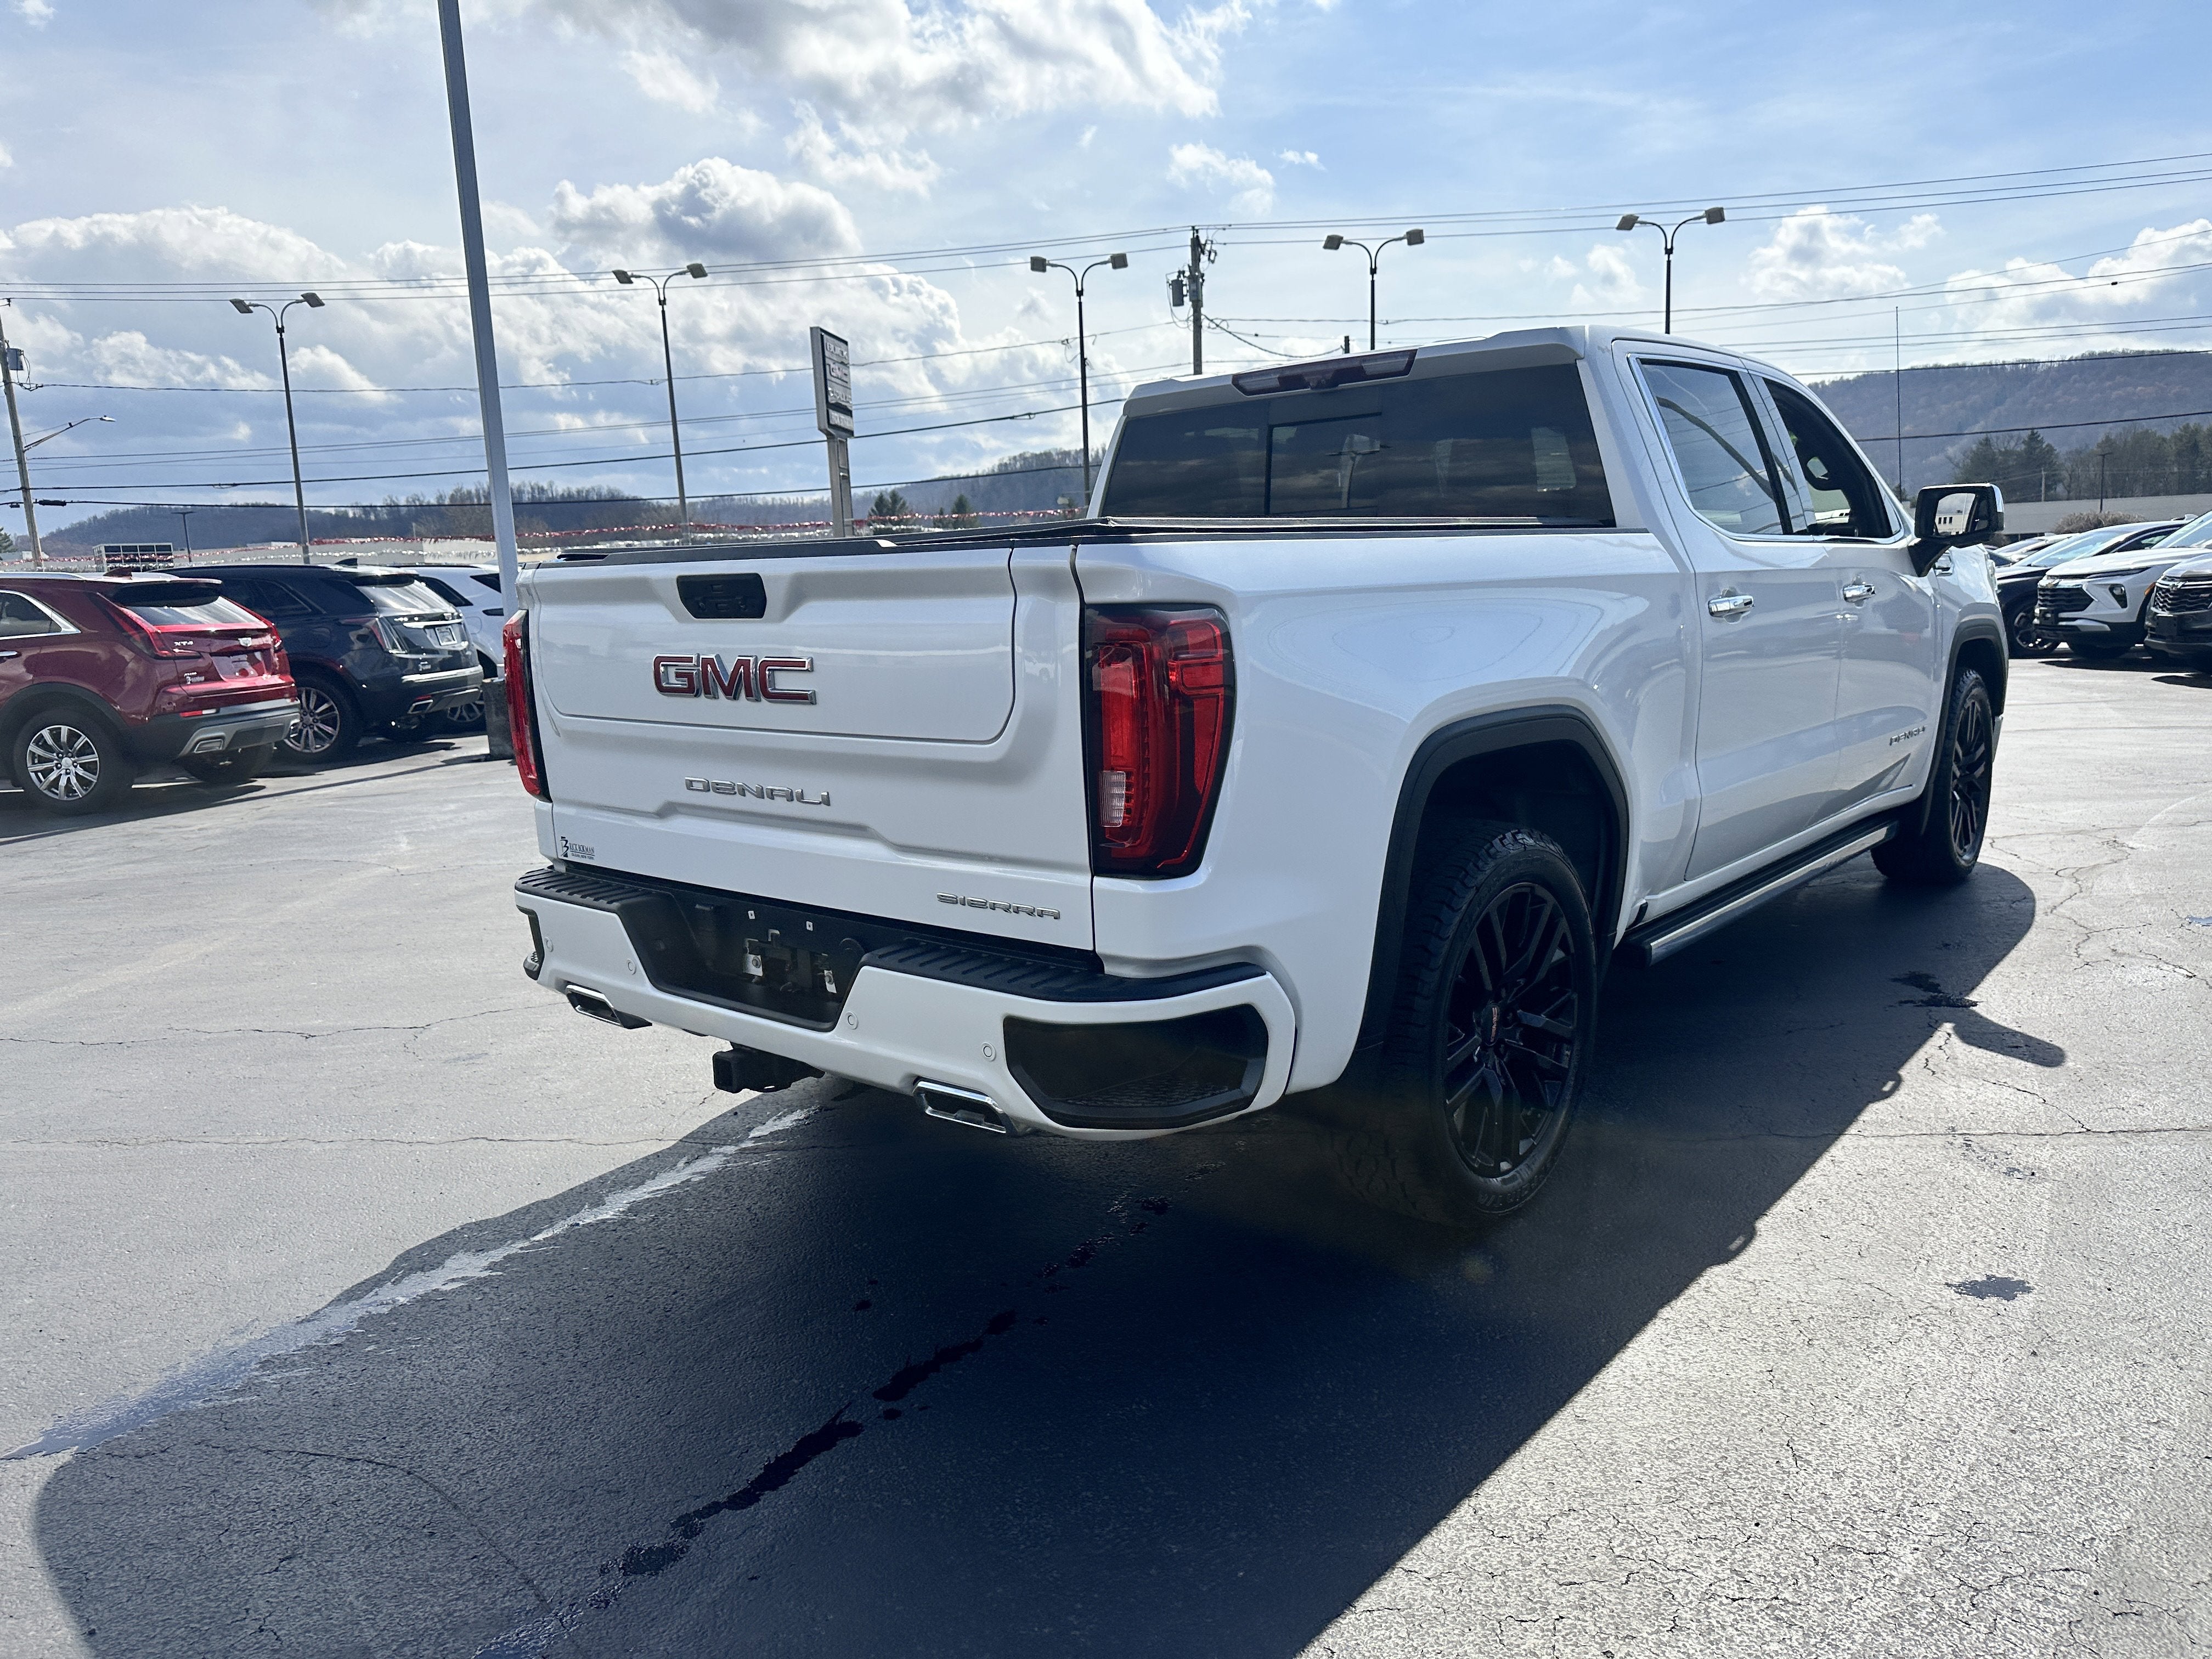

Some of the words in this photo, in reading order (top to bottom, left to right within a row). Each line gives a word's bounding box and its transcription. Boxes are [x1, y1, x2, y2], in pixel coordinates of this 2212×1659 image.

[653, 653, 817, 705] GMC
[685, 776, 830, 806] DENALI
[936, 892, 1060, 919] SIERRA
